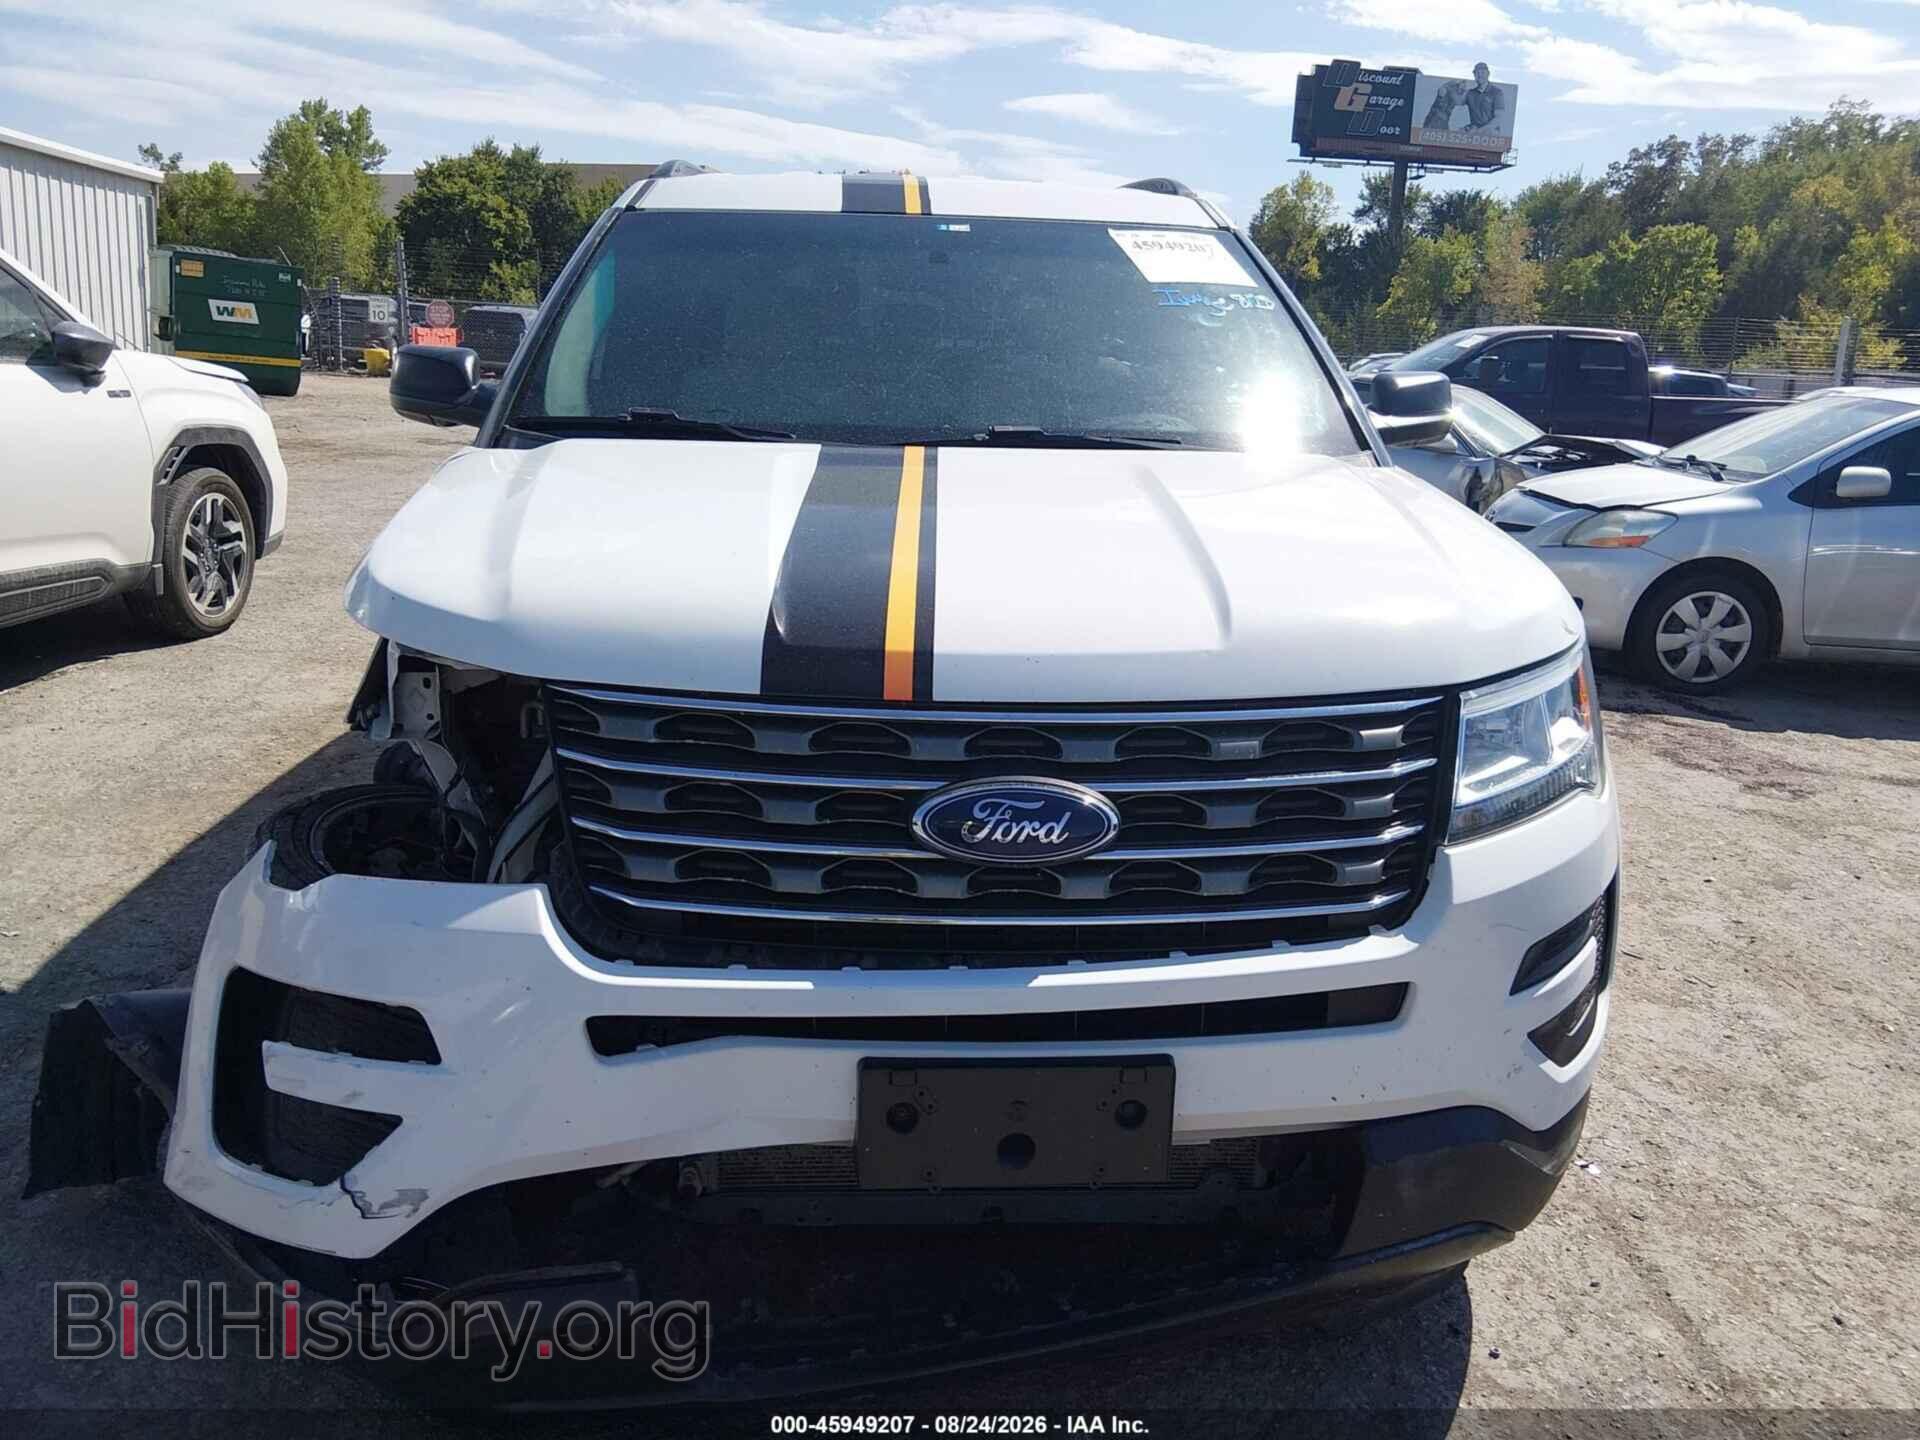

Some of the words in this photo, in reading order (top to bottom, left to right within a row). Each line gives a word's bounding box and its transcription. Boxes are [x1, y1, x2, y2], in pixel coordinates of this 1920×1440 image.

[1322, 59, 1404, 87] Discount
[1334, 82, 1405, 112] Garage
[1345, 107, 1400, 136] Door
[216, 305, 252, 319] WM
[372, 310, 386, 320] 10
[961, 798, 1071, 844] Ford
